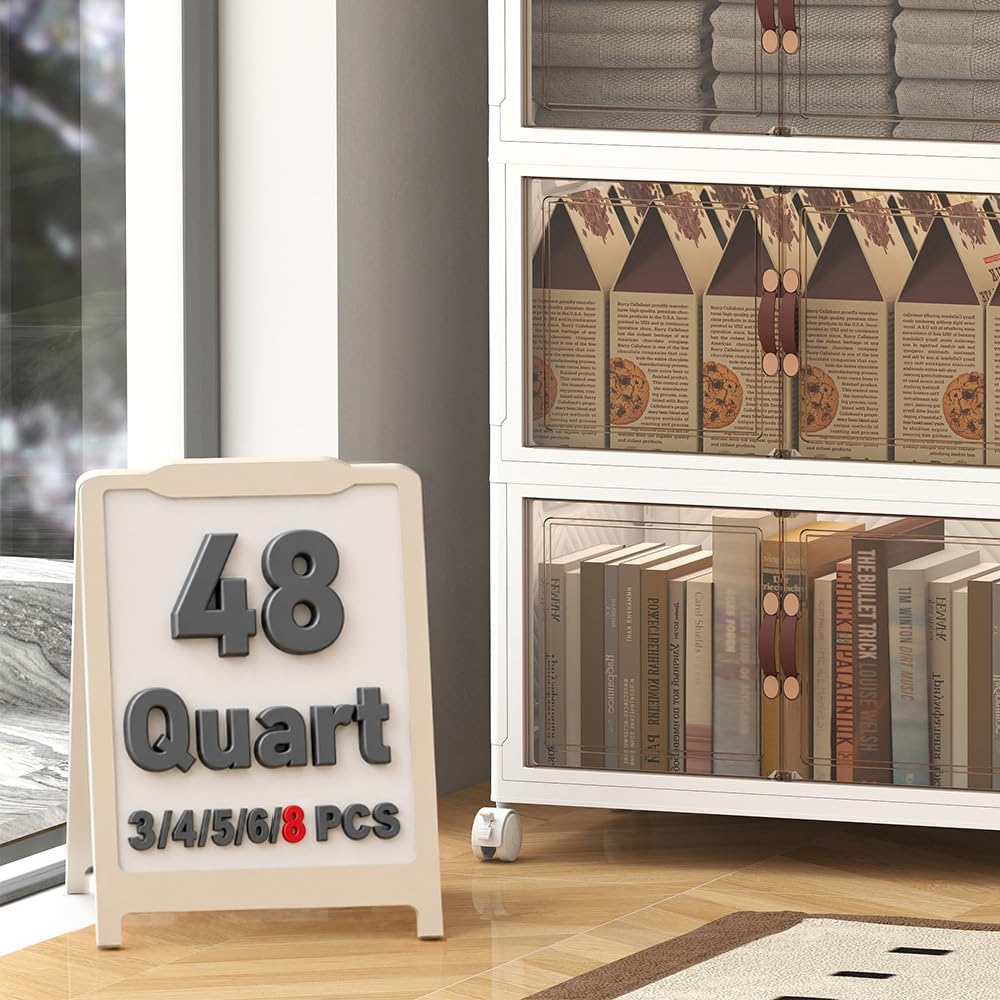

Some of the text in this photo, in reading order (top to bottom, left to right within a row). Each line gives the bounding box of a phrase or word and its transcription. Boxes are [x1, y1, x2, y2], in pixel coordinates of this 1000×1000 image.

[170, 528, 345, 658] 48
[837, 571, 852, 624] CHUCK
[856, 549, 877, 660] THE BULLET TRICK
[898, 587, 912, 643] TIM WINTON
[899, 645, 914, 701] DIRT MUSIC
[124, 686, 392, 774] Quart
[128, 803, 401, 851] 3/4/5/6/8 PCS
